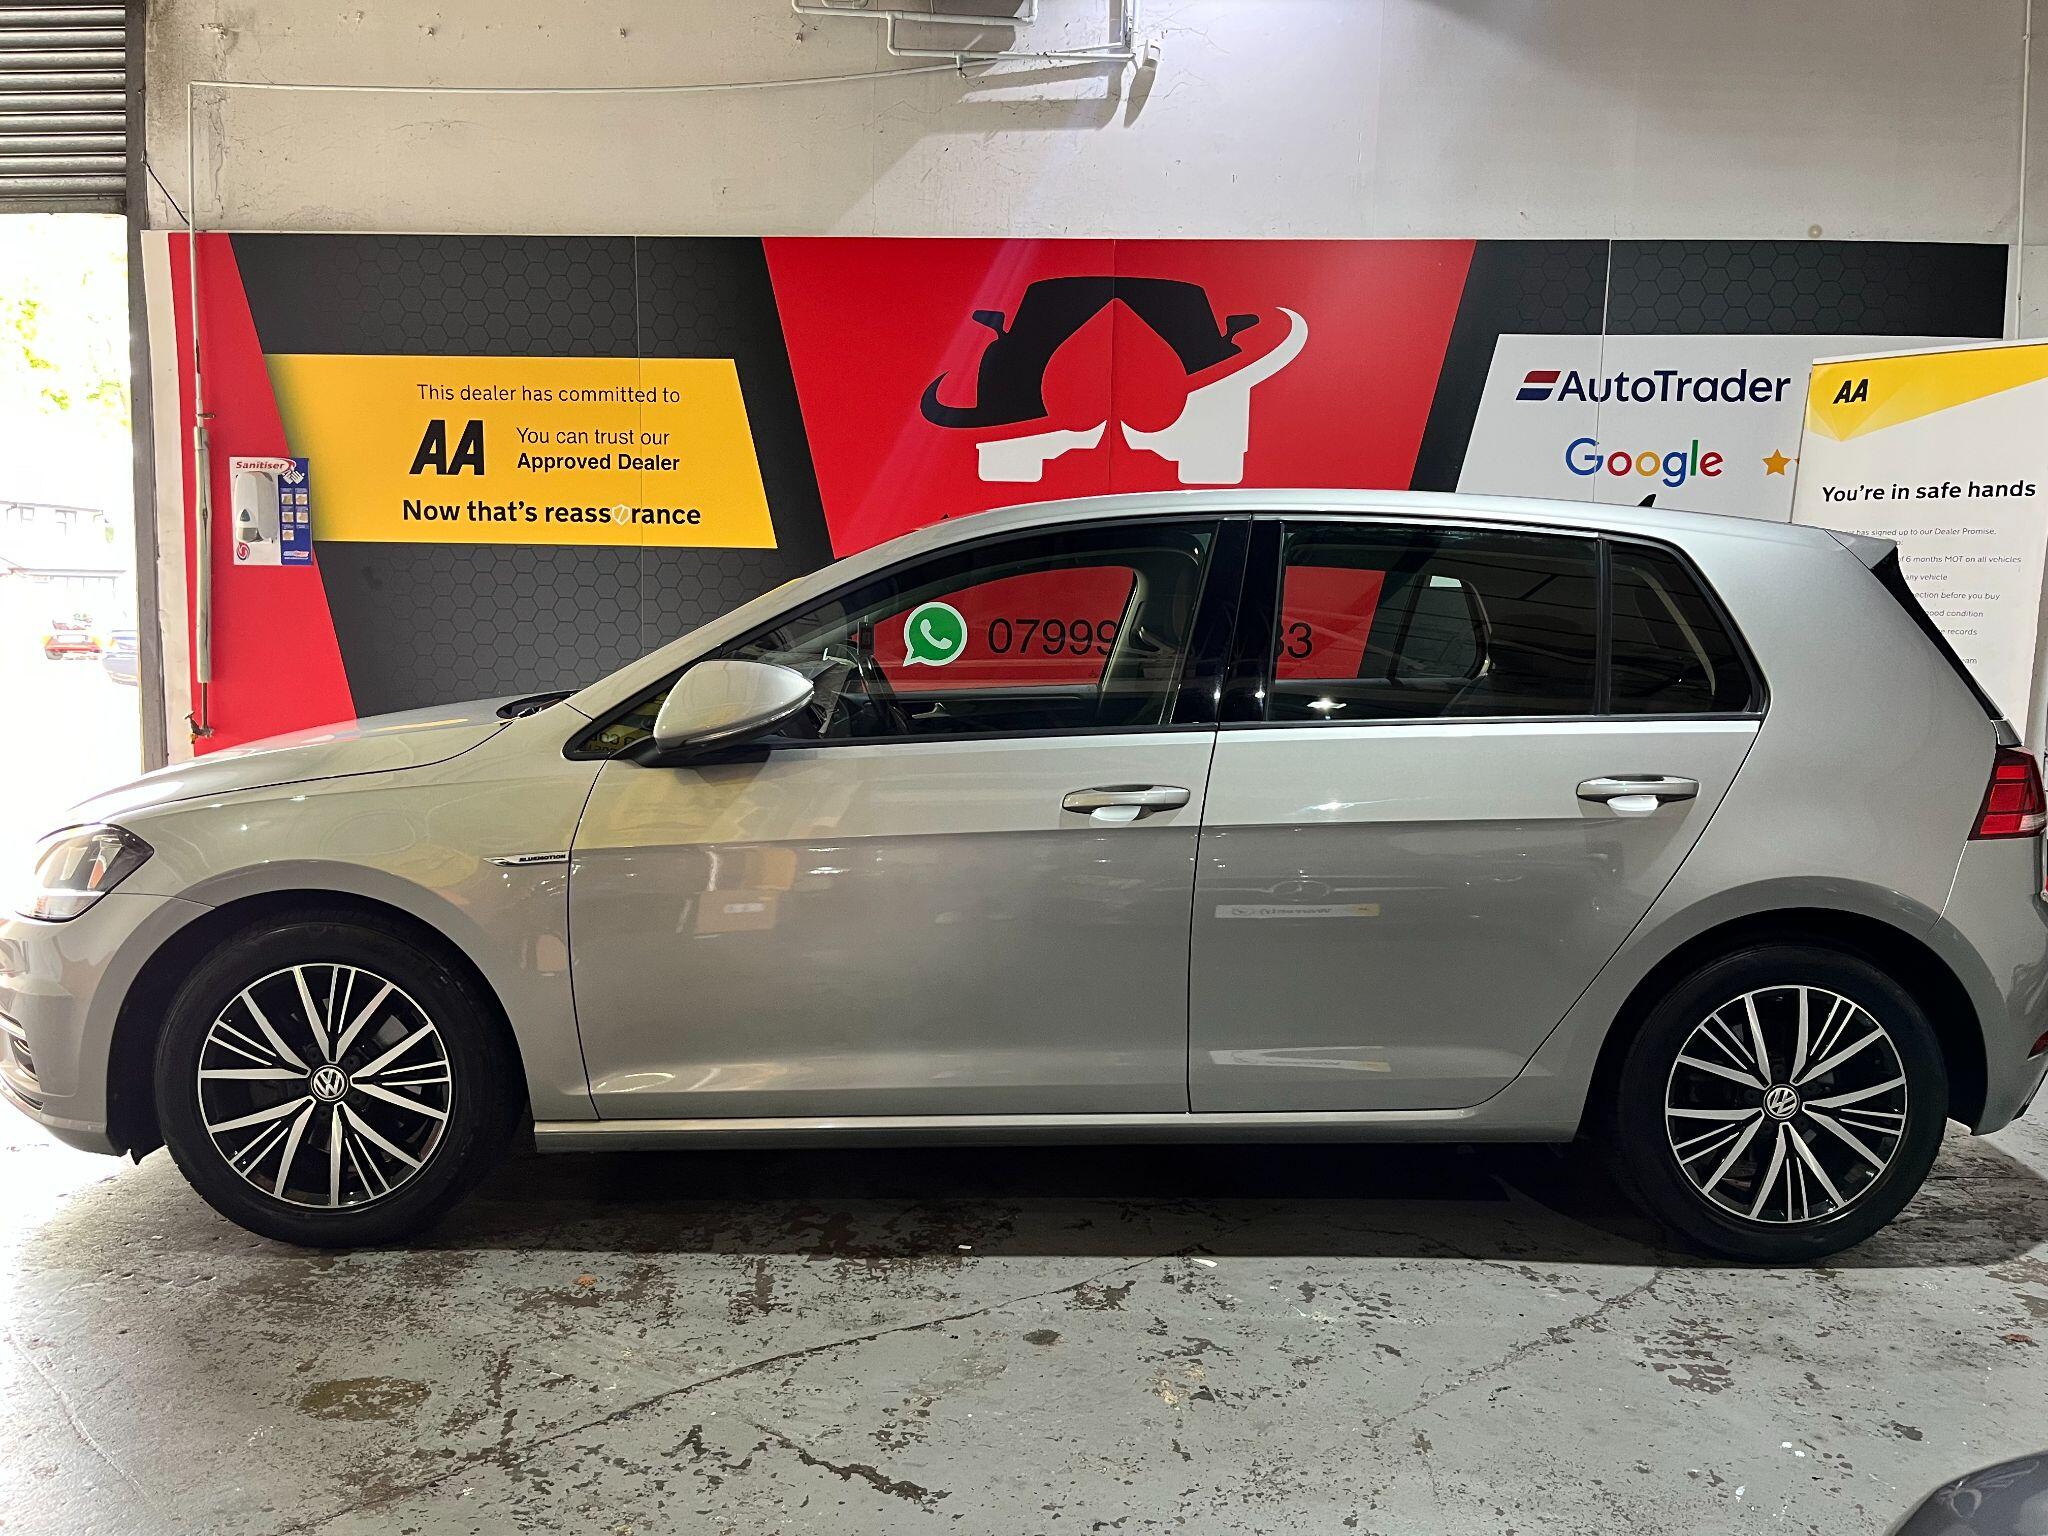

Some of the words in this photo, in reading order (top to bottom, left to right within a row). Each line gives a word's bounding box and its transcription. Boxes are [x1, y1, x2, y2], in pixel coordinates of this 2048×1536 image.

[416, 384, 455, 400] This
[460, 385, 517, 401] dealer
[522, 386, 553, 402] has
[558, 386, 657, 403] committed
[662, 387, 681, 403] to
[1557, 368, 1791, 403] AutoTrader
[1832, 378, 1869, 404] AA
[516, 427, 550, 444] You
[556, 431, 589, 445] can
[594, 429, 635, 445] trust
[640, 431, 670, 446] our
[409, 419, 485, 475] AA
[235, 461, 285, 470] Sanitiser
[516, 452, 611, 473] Approved
[617, 454, 680, 471] Dealer
[1565, 437, 1724, 488] Google
[1822, 484, 1886, 502] You're
[1891, 483, 1910, 500] in
[1915, 481, 1962, 499] safe
[1967, 480, 2037, 498] hands
[403, 499, 461, 521] Now
[467, 501, 538, 522] that's
[1871, 529, 1897, 537] signed
[1934, 527, 1961, 535] Dealer
[1920, 573, 1948, 581] vehicle
[1968, 593, 1983, 601] you
[1984, 592, 2001, 600] buy
[1947, 628, 1978, 636] records
